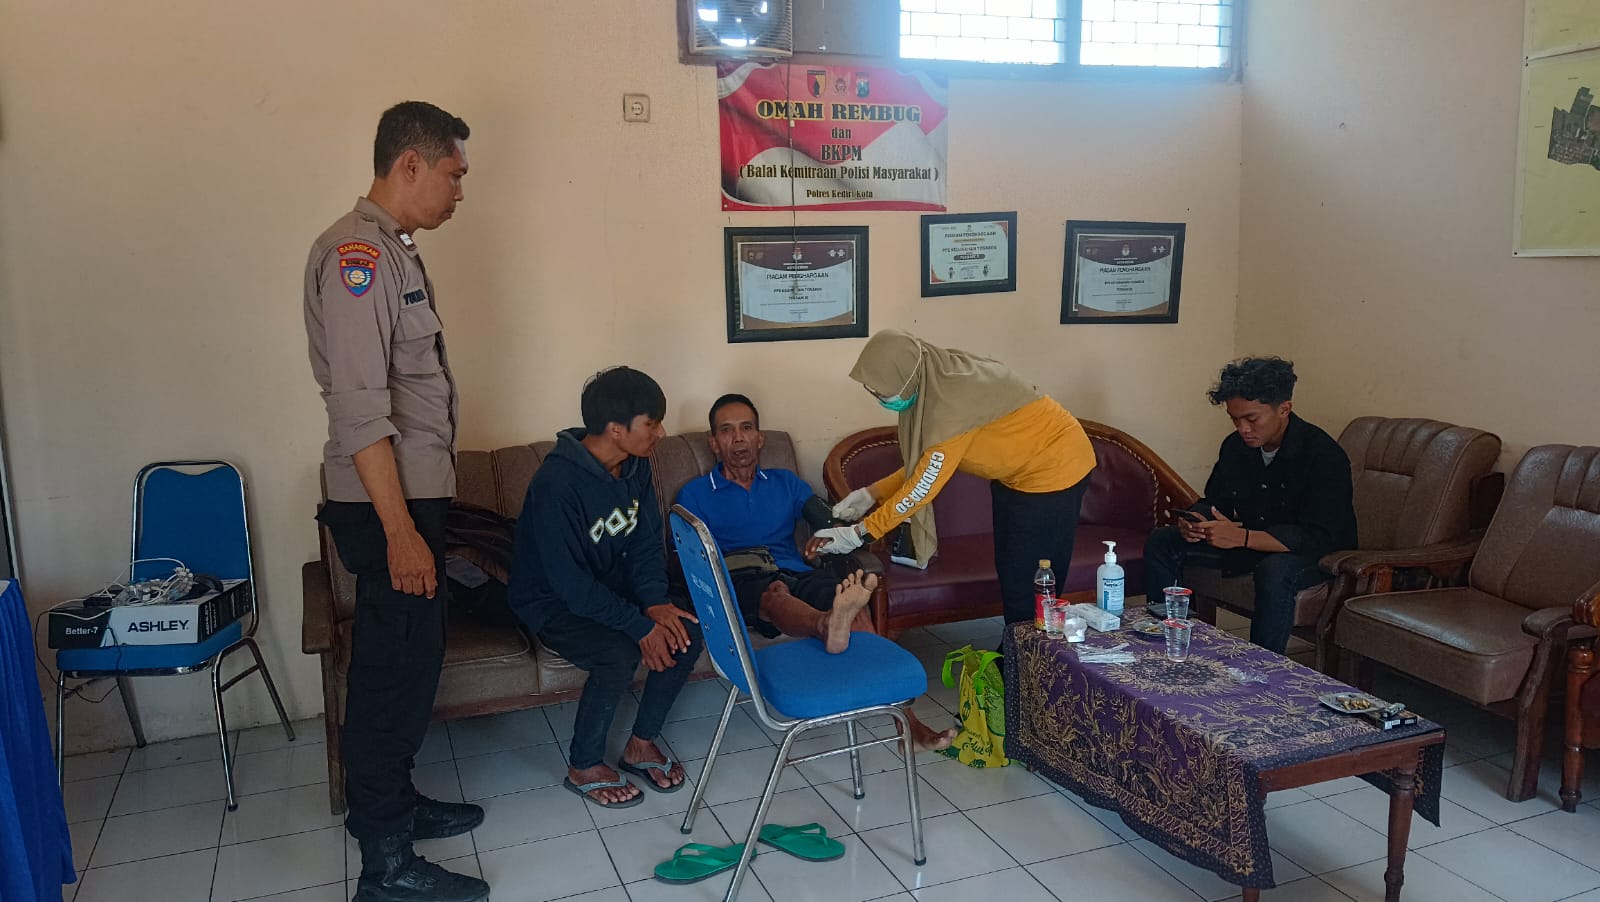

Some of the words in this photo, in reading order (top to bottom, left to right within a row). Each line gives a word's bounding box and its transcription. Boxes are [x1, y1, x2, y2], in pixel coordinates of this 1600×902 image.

[758, 100, 823, 120] OMAH
[831, 103, 921, 122] REMBUG
[831, 127, 851, 139] dan
[821, 145, 862, 161] BKPM
[746, 165, 777, 179] Balai
[780, 165, 837, 179] Kemitraan
[840, 166, 870, 180] Polisi
[872, 167, 932, 181] Masyarakat
[806, 189, 830, 198] Polres
[832, 189, 854, 198] Kediri
[65, 626, 98, 635] Better-7
[128, 619, 189, 633] ASHLEY
